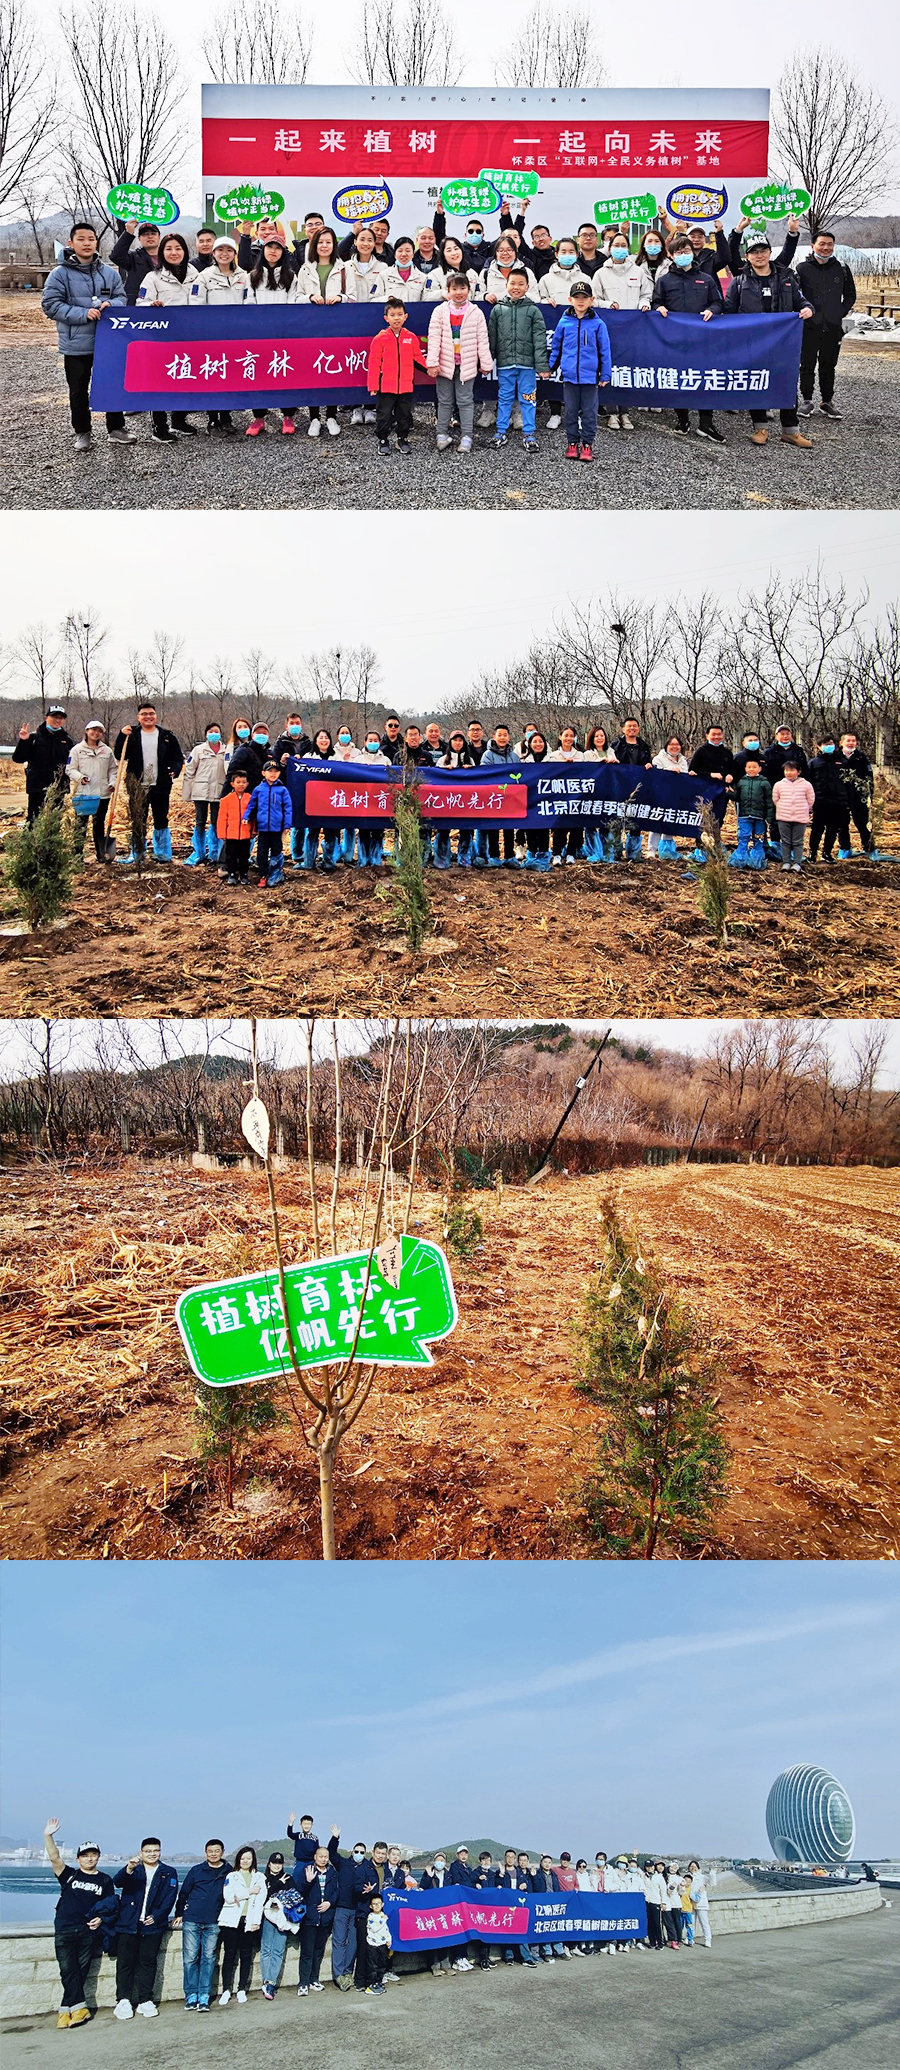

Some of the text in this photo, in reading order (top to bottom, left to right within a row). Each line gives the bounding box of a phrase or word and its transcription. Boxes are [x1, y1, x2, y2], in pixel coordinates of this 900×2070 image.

[229, 129, 436, 153] 一起来植树
[513, 130, 723, 153] 一起向未来
[115, 188, 166, 208] 补植复绿
[219, 194, 273, 208] 春风吹新绿
[336, 189, 385, 207] 拥抱春天
[448, 197, 492, 208] 护航生态
[671, 192, 720, 205] 拥抱春天
[743, 192, 798, 207] 春风吹新绿
[115, 200, 167, 219] 护航生态
[226, 203, 280, 217] 植树正当时
[344, 199, 388, 218] 播种希望
[597, 200, 642, 214] 植树育林
[610, 206, 650, 222] 亿帆先行
[676, 202, 722, 216] 播种希望
[750, 200, 805, 215] 植树正当时
[128, 320, 170, 330] YIFAN
[165, 350, 295, 381] 植树育林
[306, 765, 332, 775] YIFAN
[536, 778, 596, 795] 亿帆医药
[329, 788, 505, 811] 植树育 亿帆先行
[199, 1266, 383, 1337] 植树育林
[258, 1296, 422, 1362] 亿帆先行
